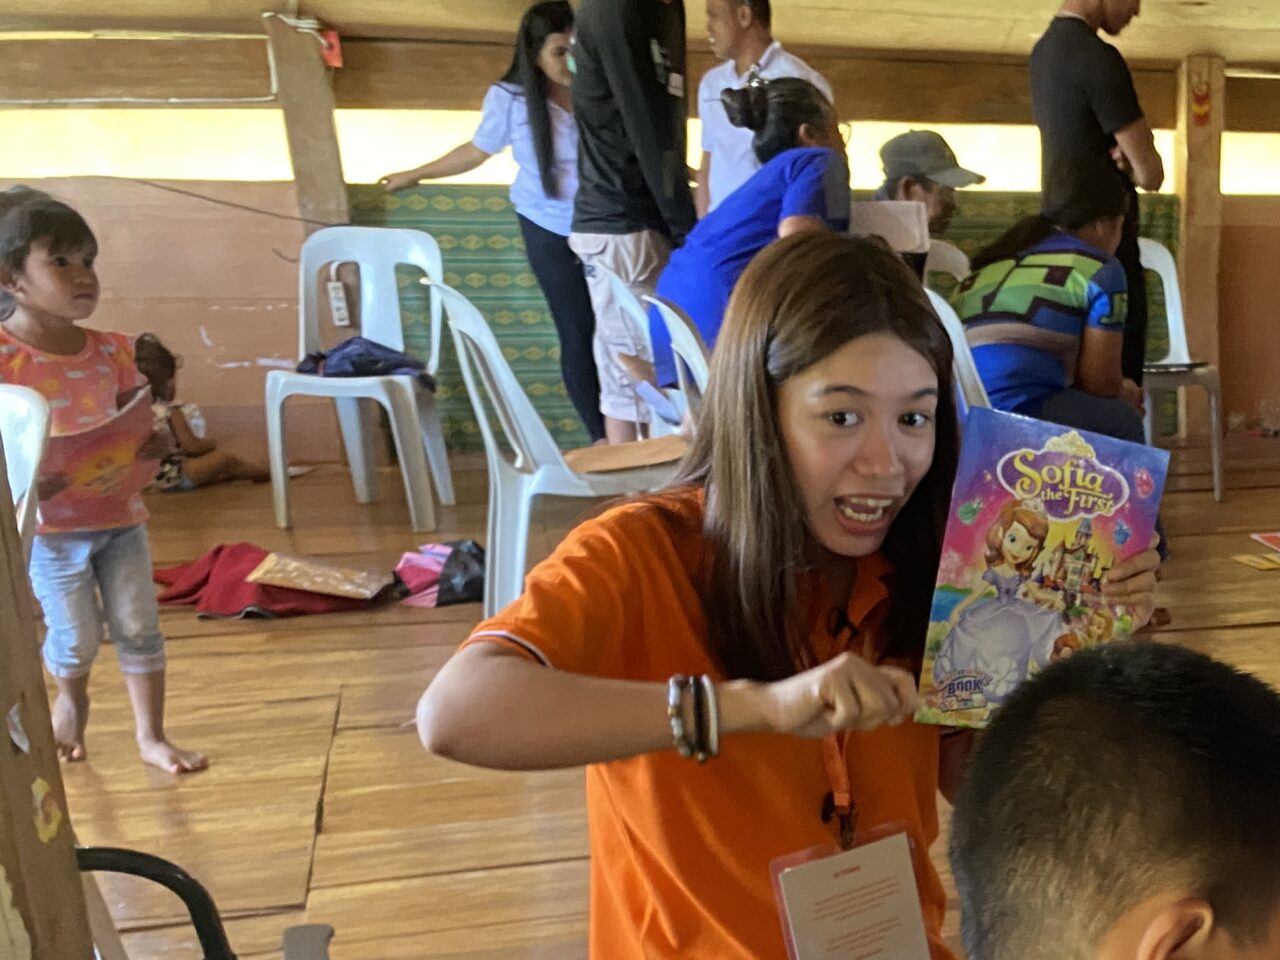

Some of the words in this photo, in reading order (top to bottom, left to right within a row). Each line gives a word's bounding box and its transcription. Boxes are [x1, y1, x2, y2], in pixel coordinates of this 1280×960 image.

[1013, 451, 1104, 499] Sofia
[1040, 489, 1063, 501] the
[1060, 485, 1114, 515] First
